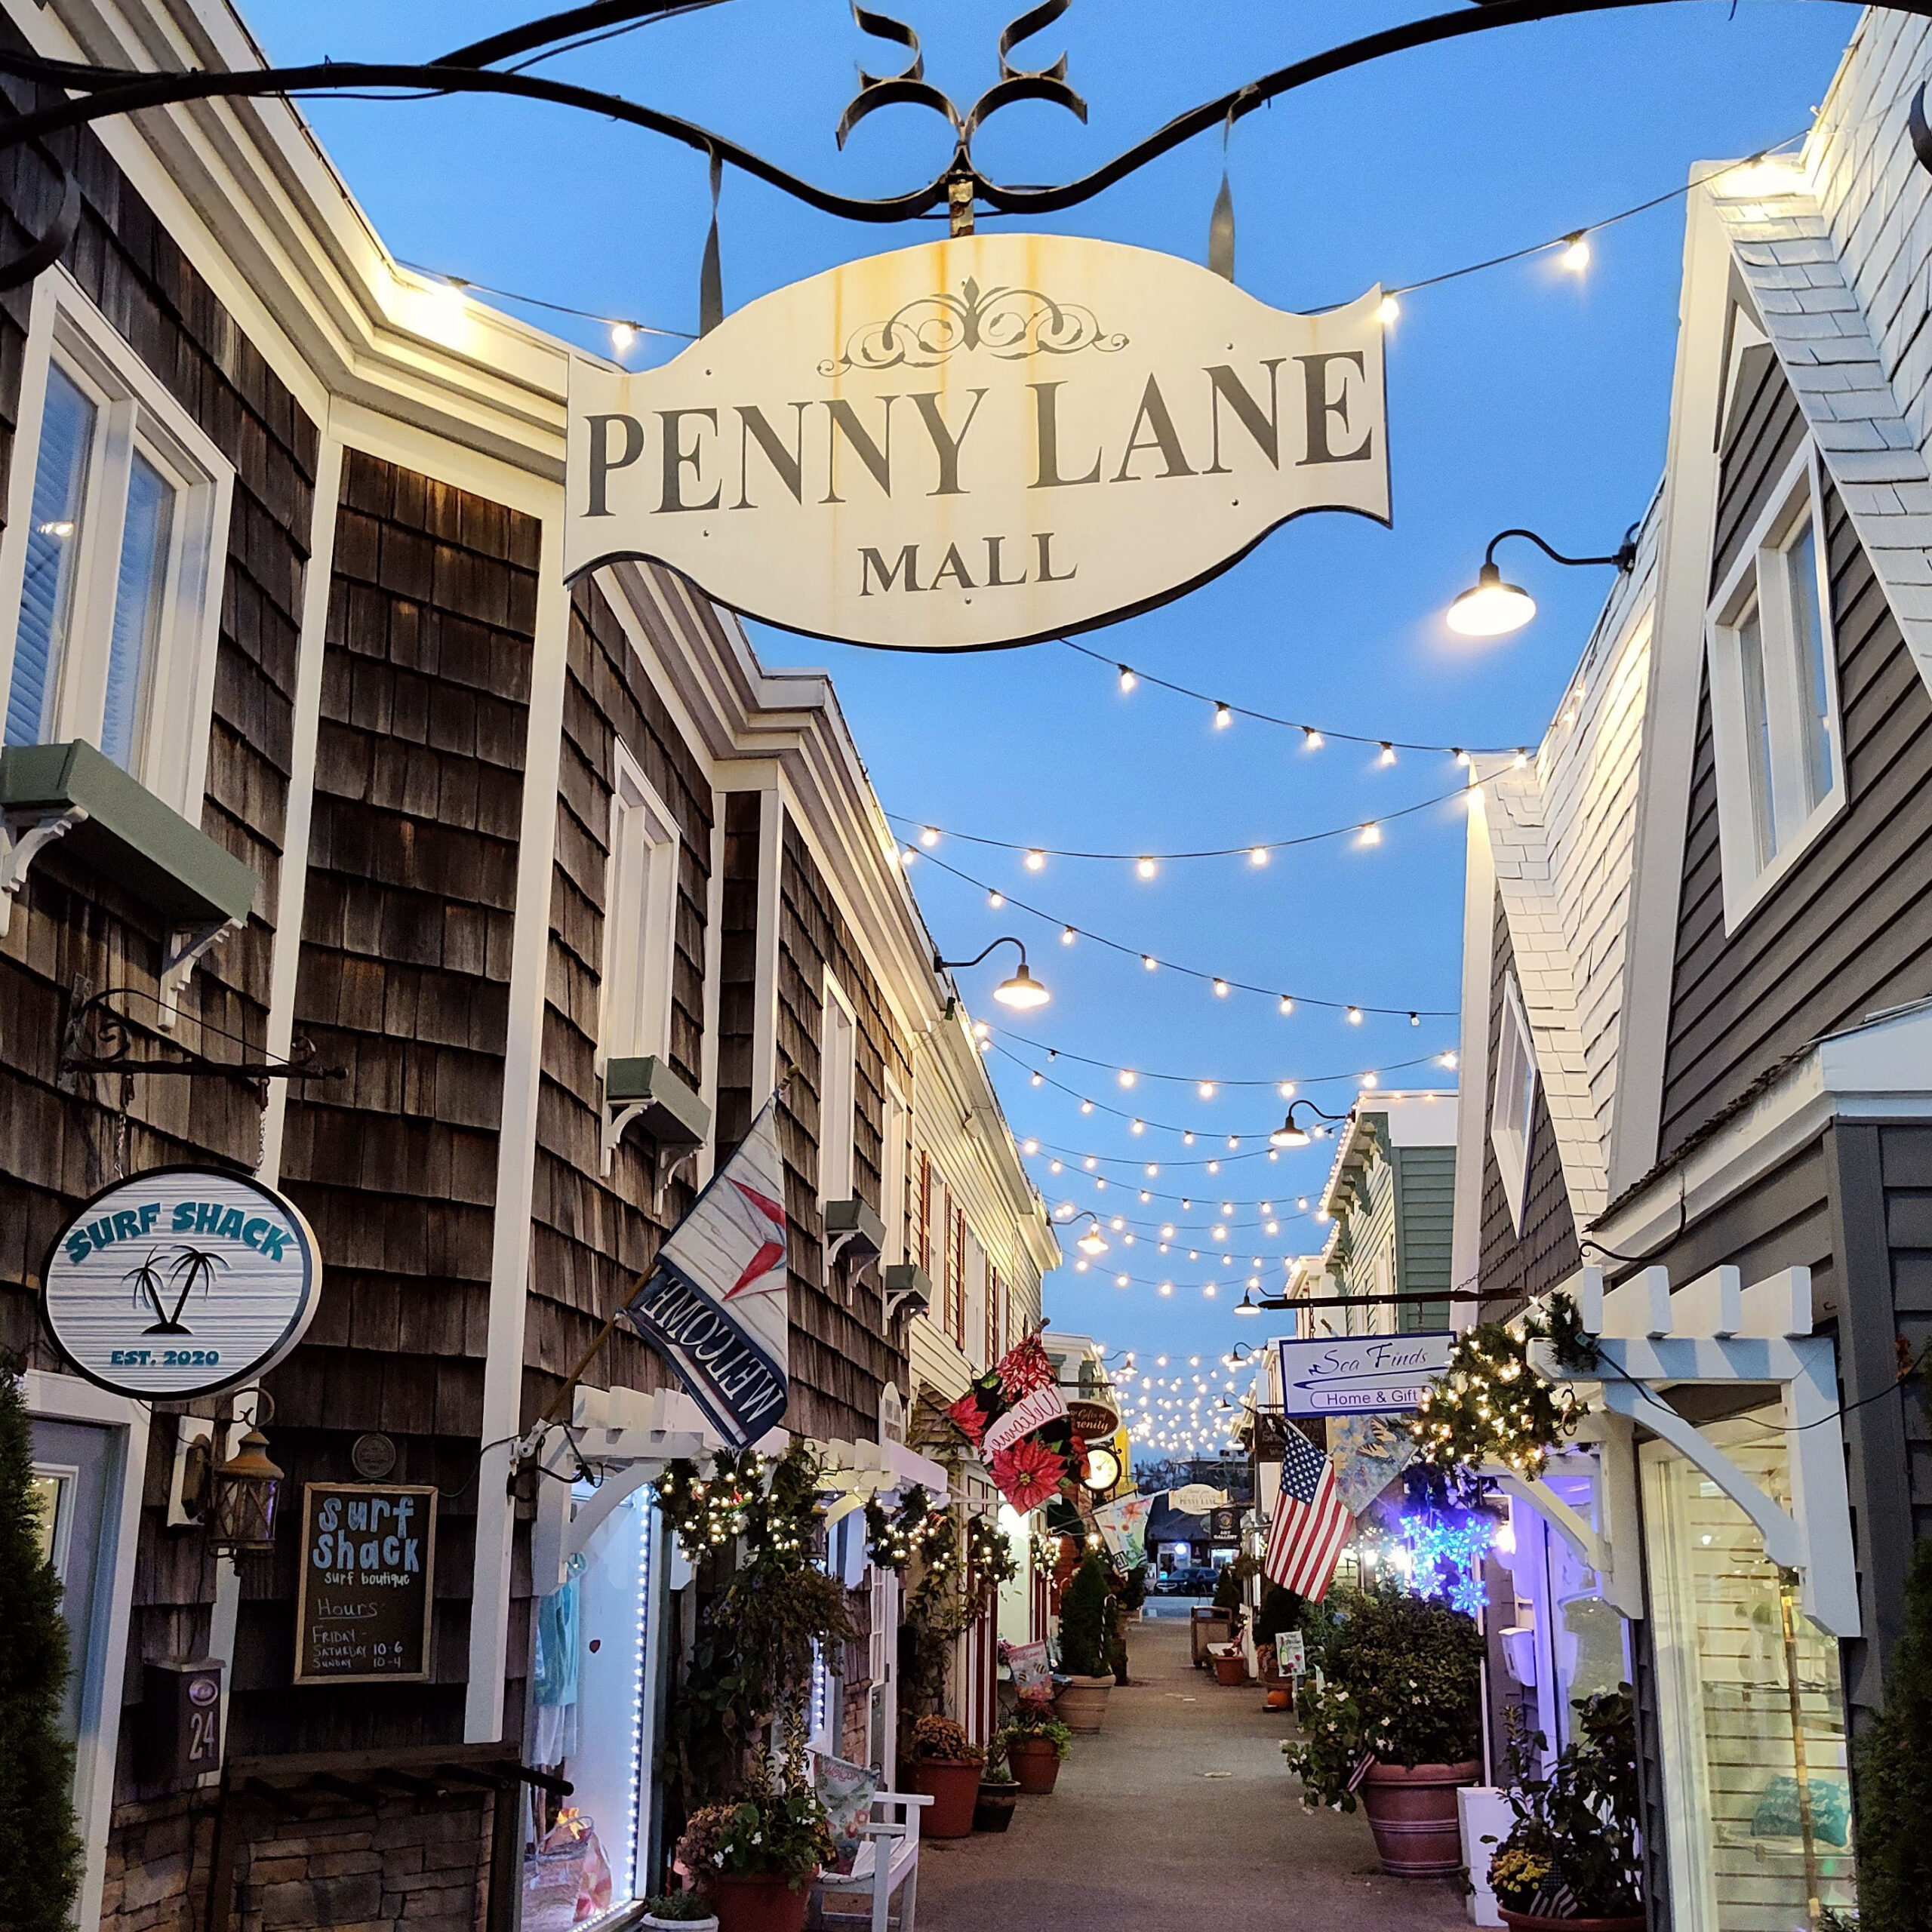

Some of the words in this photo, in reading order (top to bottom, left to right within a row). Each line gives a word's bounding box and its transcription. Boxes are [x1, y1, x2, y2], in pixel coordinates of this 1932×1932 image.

[580, 388, 989, 518] PENNY
[1025, 350, 1373, 489] LANE
[857, 532, 1078, 598] MALL
[65, 1203, 161, 1264] SURF
[171, 1201, 296, 1263] SHACK
[109, 1350, 157, 1367] EST.
[163, 1350, 220, 1367] 2020
[1308, 1349, 1360, 1376] Sea
[1366, 1342, 1429, 1368] Finds
[1327, 1392, 1371, 1406] Home
[1376, 1391, 1386, 1403] &
[1077, 1420, 1109, 1434] renity
[318, 1496, 414, 1539] Surf
[312, 1529, 420, 1573] Shack
[325, 1573, 354, 1586] surf
[361, 1572, 411, 1588] boutique
[189, 1711, 215, 1761] 24
